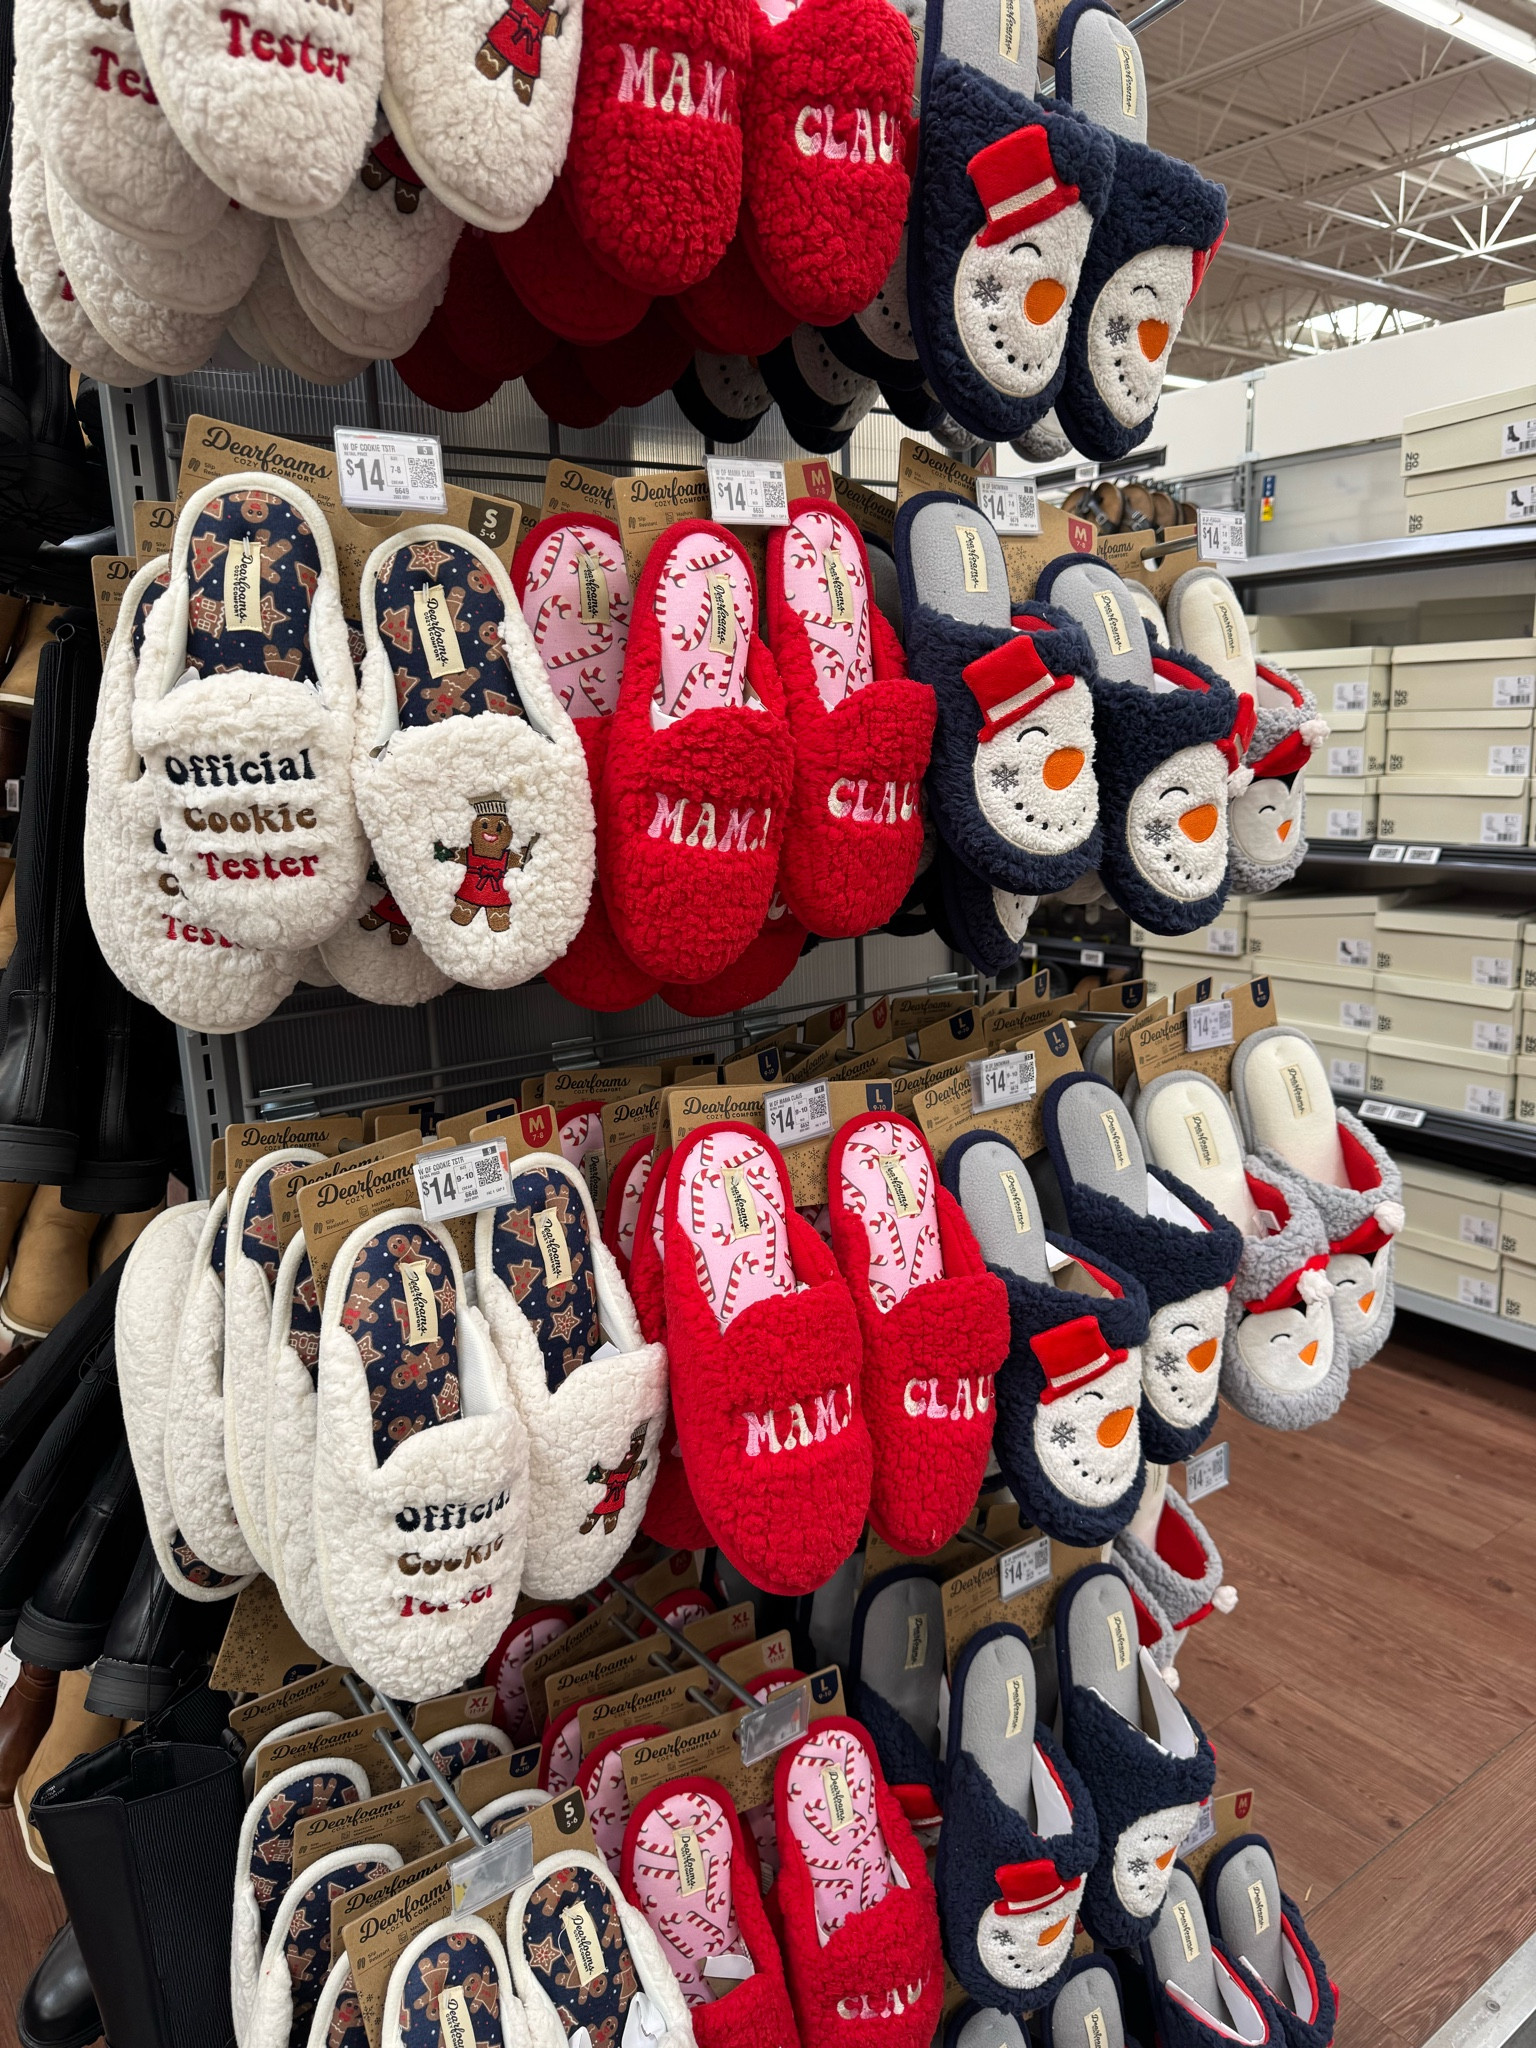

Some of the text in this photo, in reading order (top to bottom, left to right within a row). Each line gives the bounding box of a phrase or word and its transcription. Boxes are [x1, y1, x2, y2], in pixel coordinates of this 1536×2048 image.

[220, 8, 351, 84] Tester
[90, 46, 160, 105] Tes
[795, 104, 901, 164] CLAU
[202, 426, 332, 479] Dearfoams
[343, 443, 396, 453] W COOKIE TSTR
[234, 456, 316, 484] COZY COMFORT
[346, 458, 385, 491] $14
[390, 466, 402, 474] 7-8
[811, 469, 825, 486] M
[560, 470, 614, 510] Dearf
[584, 496, 603, 505] COZY
[631, 477, 709, 507] Dearfoam
[718, 482, 746, 511] $14
[834, 477, 895, 514] Dearfoam
[655, 500, 671, 508] COZY
[983, 495, 1005, 520] $14
[483, 509, 498, 528] S
[480, 529, 496, 540] 5-6
[1075, 526, 1088, 542] M
[1203, 527, 1219, 549] $14
[965, 530, 977, 588] Dearfoams
[240, 554, 253, 623] Dearfoams
[829, 561, 844, 616] Dearfoams
[713, 584, 726, 645] Dearfoams
[1101, 595, 1122, 651] Dearfoams
[426, 597, 449, 667] Dearfoams
[429, 633, 441, 662] COMFORT
[165, 748, 317, 787] Official
[827, 777, 919, 824] CLAU
[183, 802, 317, 834] Cookie
[198, 851, 319, 881] Tester
[1129, 988, 1135, 998] L
[1201, 985, 1206, 995] L
[1257, 983, 1263, 995] L
[958, 1018, 966, 1028] L
[992, 1009, 1053, 1032] Dearfoams
[1193, 1015, 1209, 1037] $14
[1053, 1032, 1061, 1044] L
[764, 1068, 774, 1076] 9-10
[765, 1056, 772, 1068] L
[555, 1073, 631, 1094] Dearfoams
[894, 1065, 962, 1095] Dearfoams
[985, 1070, 1006, 1094] $14
[875, 1089, 883, 1103] L
[529, 1115, 545, 1133] M
[771, 1107, 794, 1133] $14
[241, 1126, 330, 1148] Dearfoams
[532, 1133, 544, 1141] 7-8
[1106, 1114, 1123, 1165] Dearfoams
[1192, 1115, 1211, 1165] Dearfoams
[418, 1156, 464, 1176] W COOKIE TSTR
[456, 1171, 474, 1183] 9-10
[317, 1163, 414, 1208] Dearfoams
[345, 1179, 411, 1205] COZY COMFORT
[422, 1173, 456, 1205] $14
[372, 1202, 395, 1213] Washable
[1006, 1174, 1025, 1229] Dearfoams
[327, 1219, 349, 1229] Resistant
[903, 1373, 995, 1421] CLAU
[1005, 1560, 1022, 1584] $14
[731, 1612, 750, 1626] XL
[766, 1644, 786, 1658] XL
[557, 1651, 638, 1691] Dearfoams
[818, 1689, 832, 1699] 9-10
[820, 1678, 828, 1691] L
[241, 1677, 329, 1722] Dearfoams
[469, 1696, 489, 1709] XL
[592, 1686, 676, 1721] Dearfoams
[1012, 1679, 1021, 1734] Dearfoams
[270, 1728, 363, 1762] Dearfoams
[634, 1728, 721, 1765] Dearfoams
[656, 1740, 712, 1764] COZY COMFORT
[519, 1756, 527, 1766] L
[690, 1764, 708, 1775] Foam
[564, 1801, 575, 1818] S
[828, 1771, 844, 1824] Dearfoams
[307, 1800, 405, 1836] Dearfoams
[331, 1823, 350, 1833] COZY
[360, 1810, 393, 1823] COMFORT
[566, 1817, 578, 1828] 5-6
[364, 1832, 383, 1841] Foam
[681, 1834, 697, 1889] Dearfoams
[345, 1861, 447, 1914] Dearfoams
[360, 1879, 452, 1944] Dearfoams
[385, 1921, 404, 1935] COZY
[413, 1896, 447, 1918] COMFORT
[410, 1918, 429, 1932] Machine
[572, 1915, 595, 1975] Dearfoams
